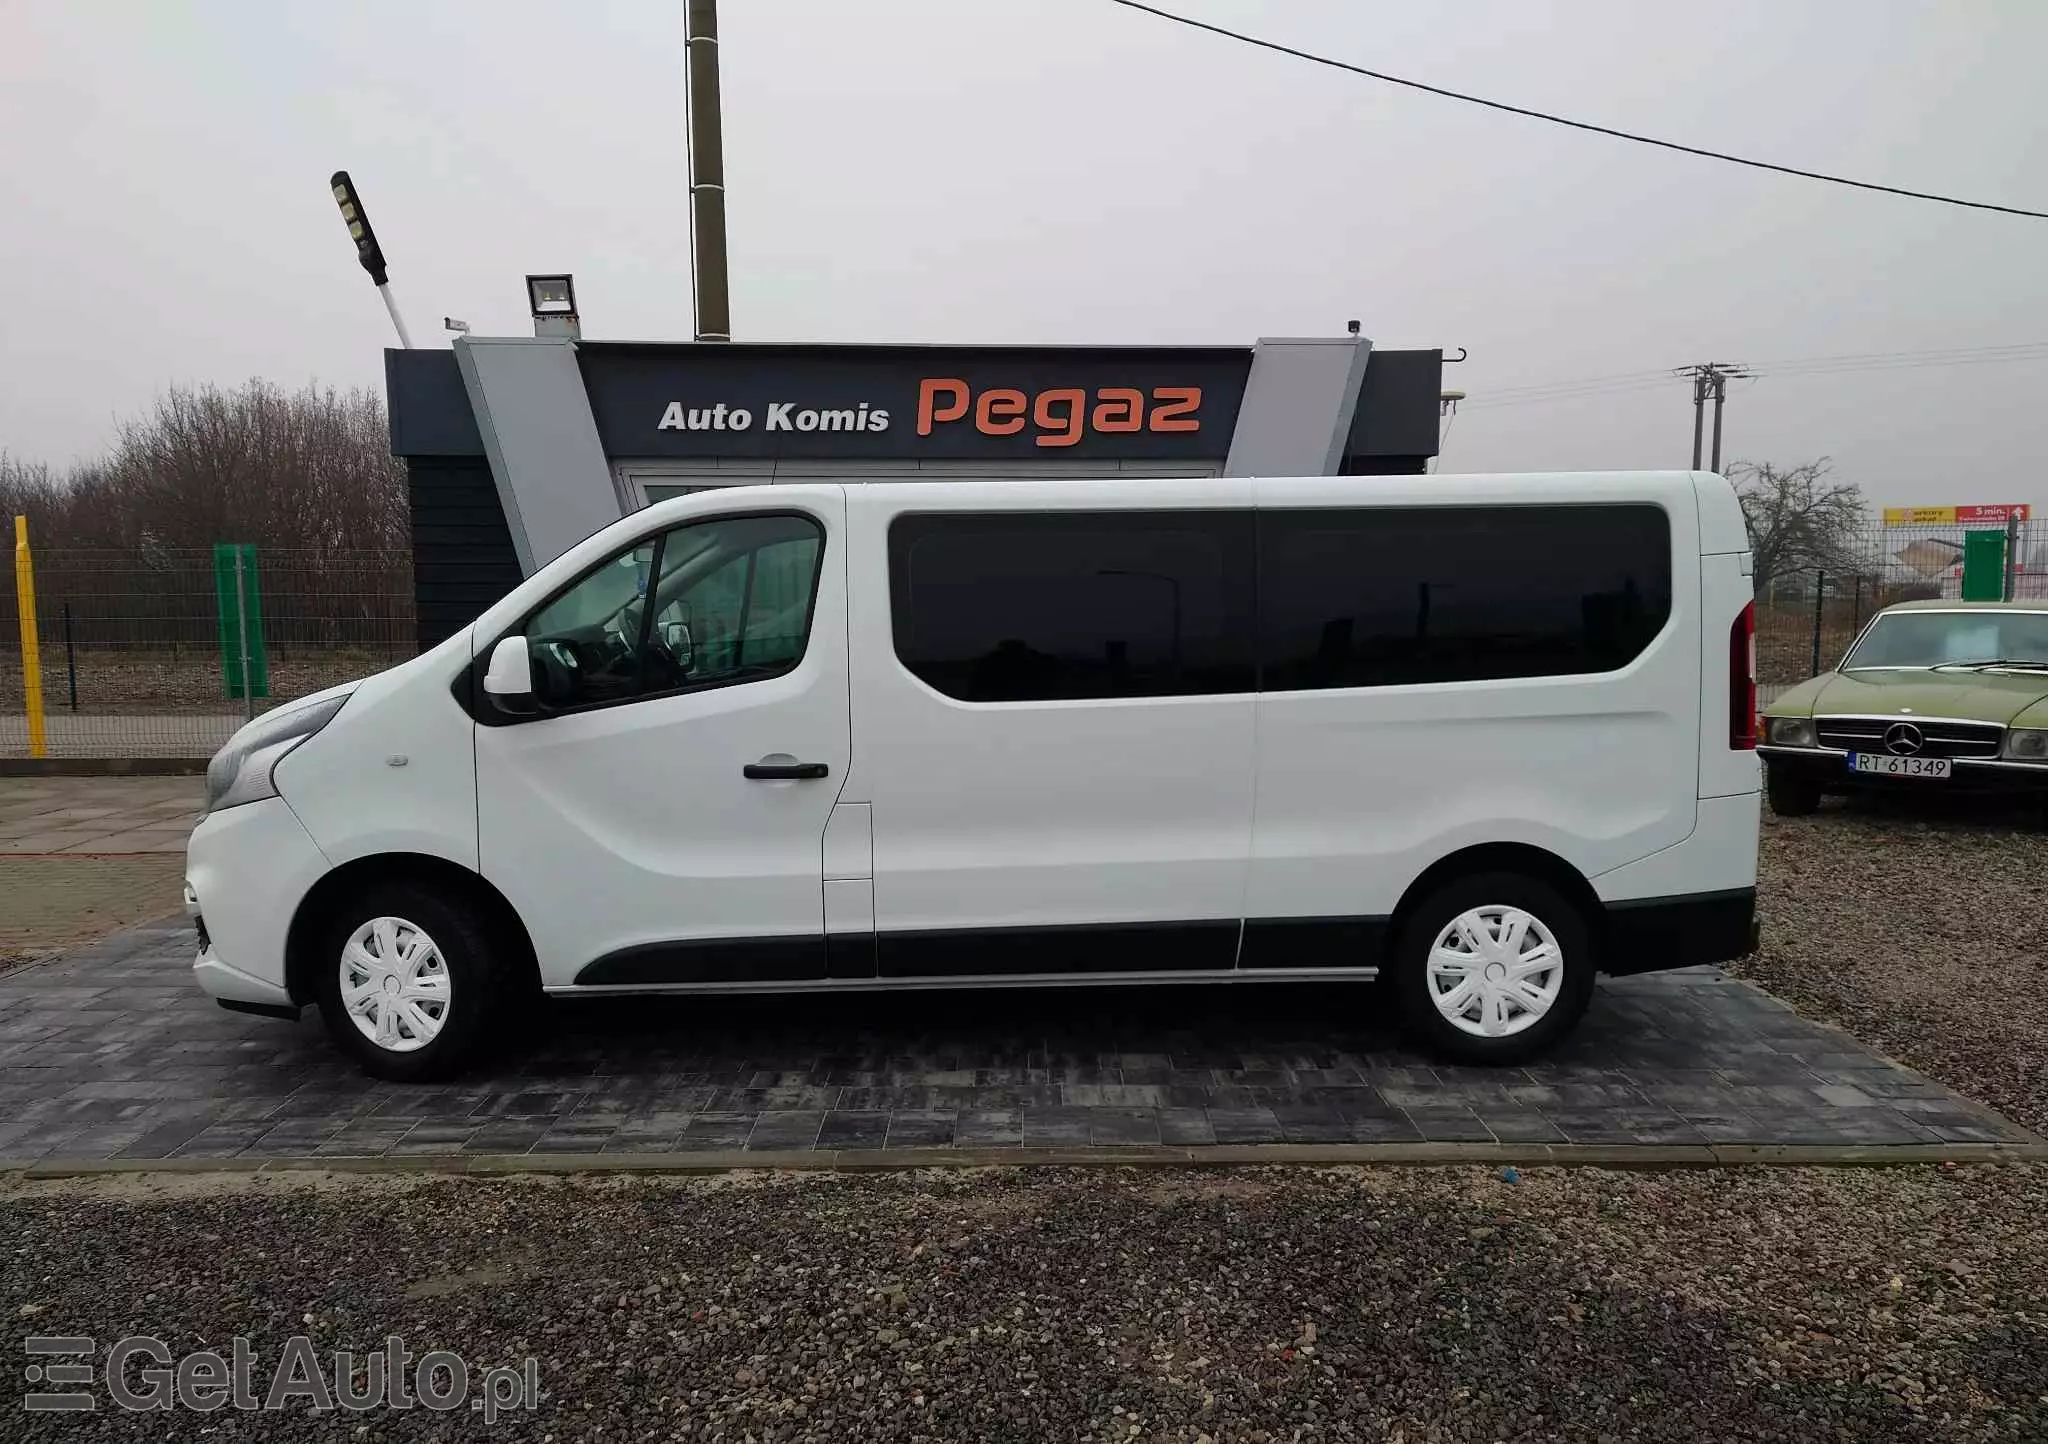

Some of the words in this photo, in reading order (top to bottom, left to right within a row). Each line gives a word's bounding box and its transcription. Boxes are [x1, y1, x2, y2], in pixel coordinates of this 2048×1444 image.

[656, 401, 752, 432] Auto
[764, 401, 890, 432] Komis
[916, 378, 1202, 447] Pegaz
[1859, 754, 1882, 771] RT
[1888, 757, 1946, 776] 61349
